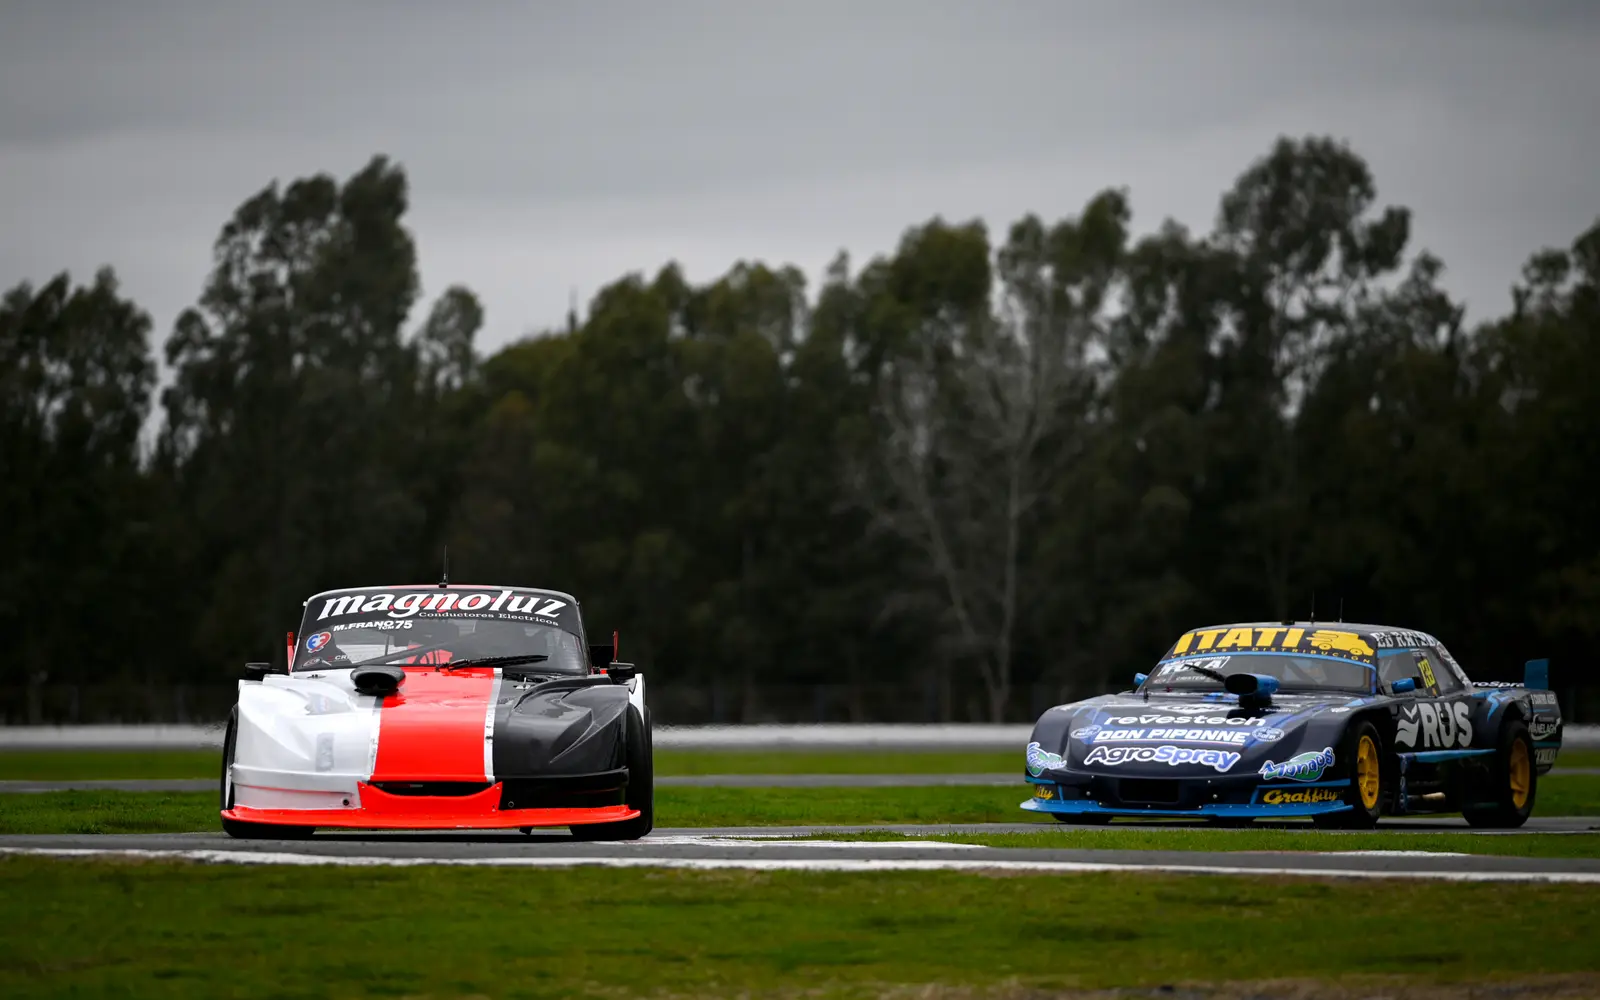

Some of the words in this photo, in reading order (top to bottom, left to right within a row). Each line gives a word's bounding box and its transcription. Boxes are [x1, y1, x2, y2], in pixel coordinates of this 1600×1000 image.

[316, 590, 567, 621] magnoluz
[395, 620, 413, 630] 75
[418, 611, 495, 619] Conductores
[498, 612, 559, 626] Electricos
[1172, 627, 1305, 655] ITATI
[1104, 714, 1266, 727] revestech
[1417, 701, 1473, 748] RUS
[1094, 728, 1146, 741] DON
[1147, 729, 1250, 743] PIPONNE
[1084, 745, 1241, 773] AgroSpray
